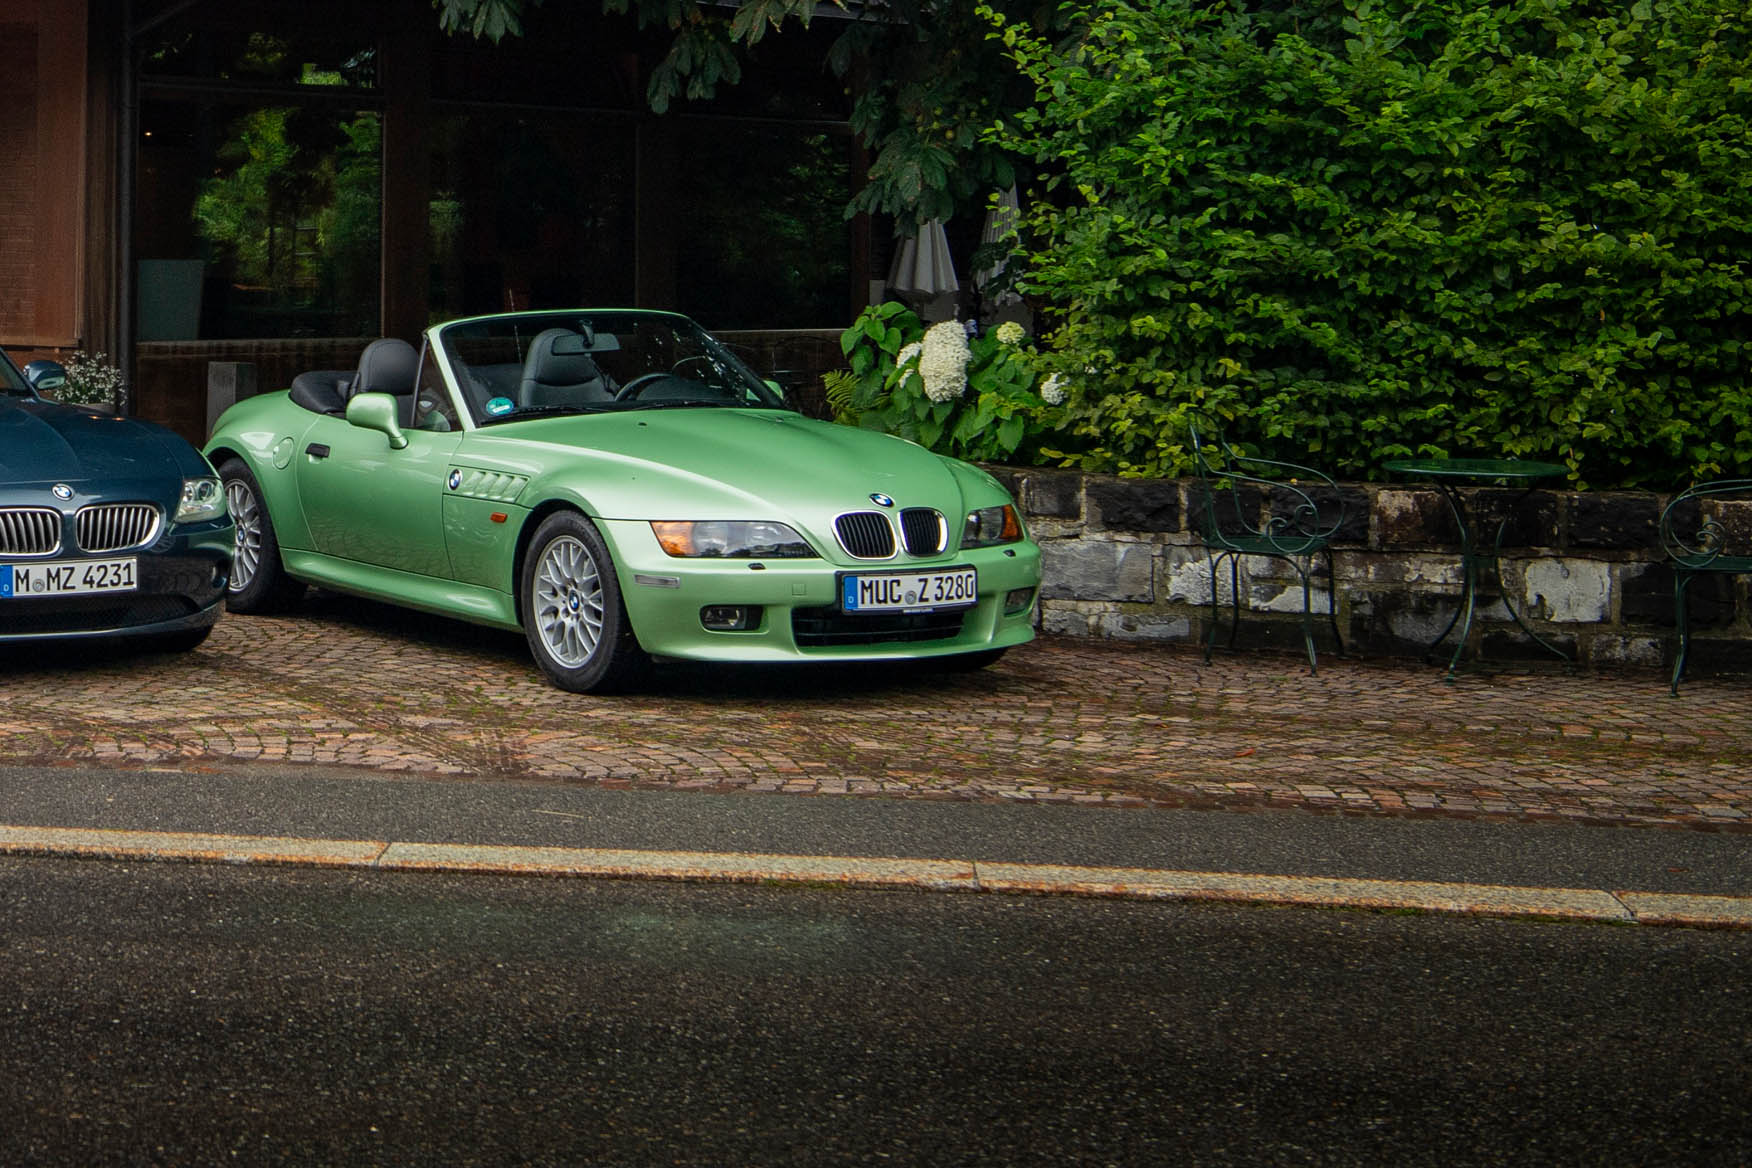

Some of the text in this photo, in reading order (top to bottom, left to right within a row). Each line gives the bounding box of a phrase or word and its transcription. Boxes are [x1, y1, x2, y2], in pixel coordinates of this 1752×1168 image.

[15, 569, 30, 592] M
[46, 567, 76, 591] MZ
[82, 563, 135, 589] 4231
[860, 579, 902, 605] MUC
[918, 578, 929, 603] Z
[934, 574, 974, 601] 3280
